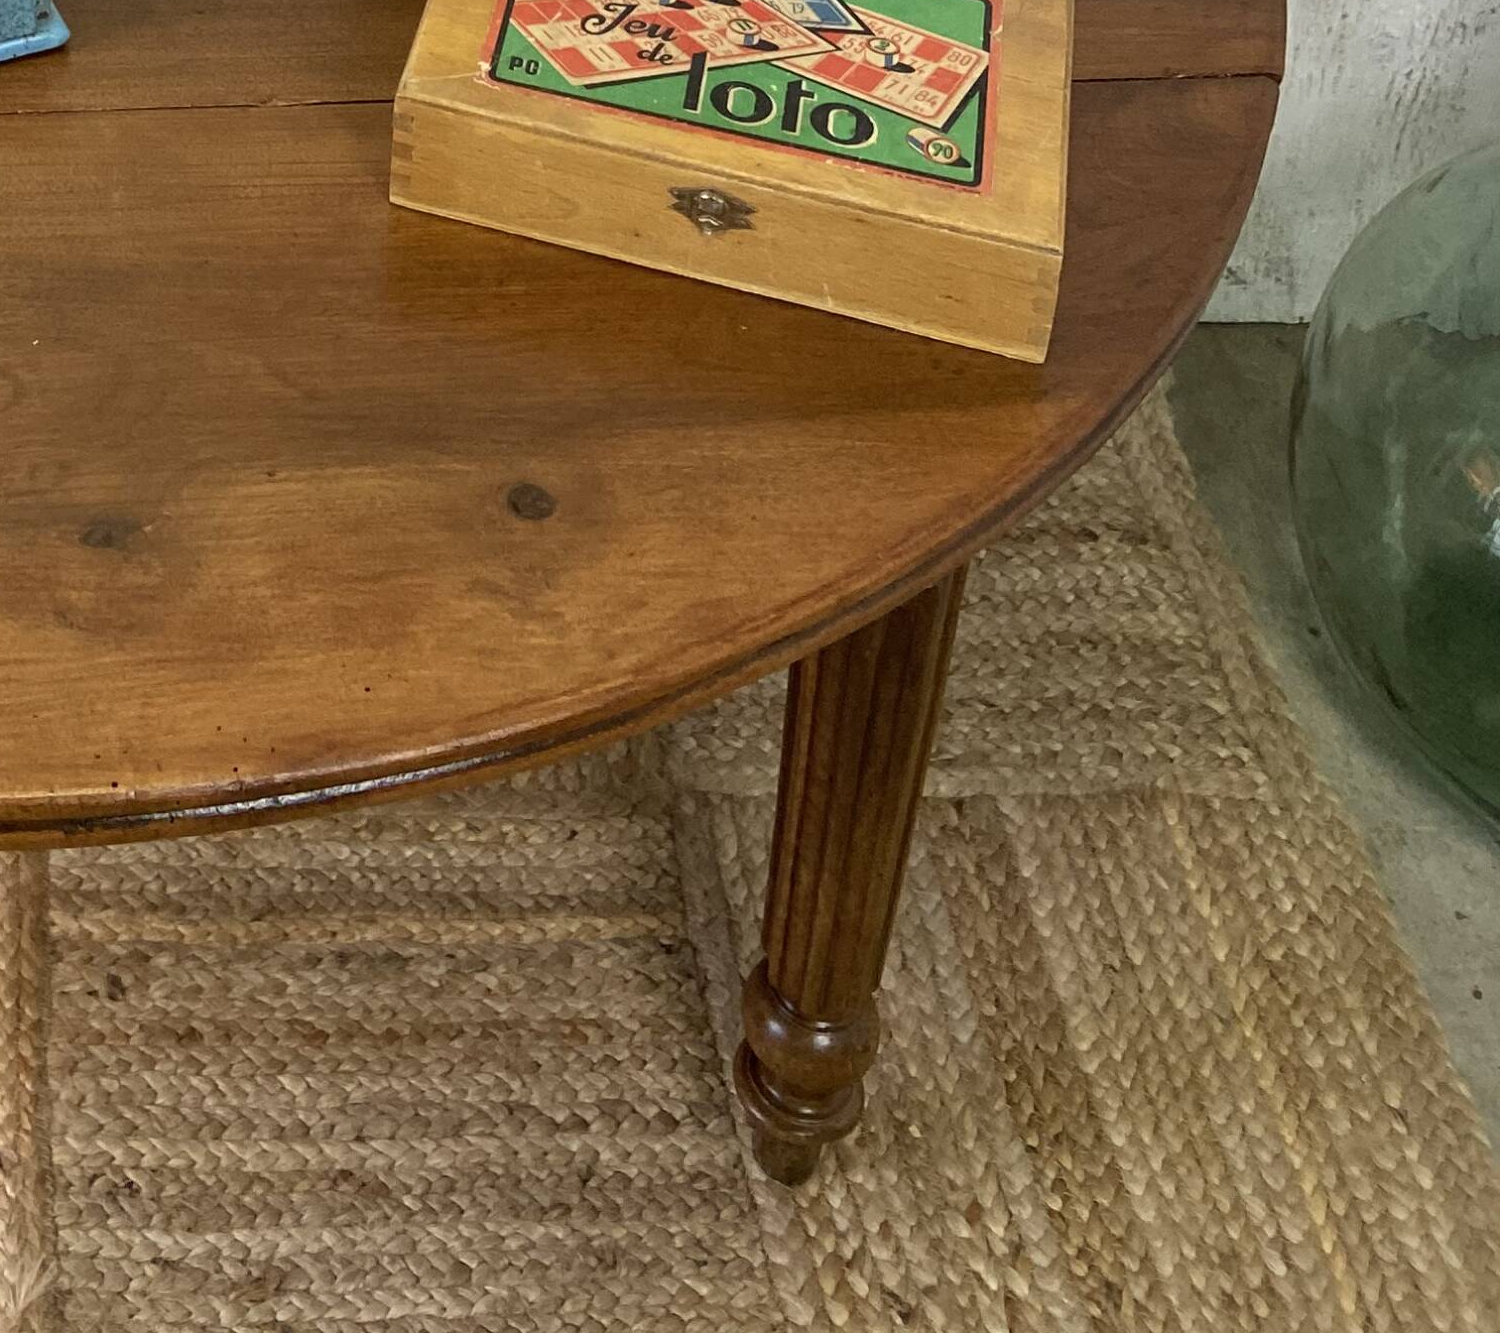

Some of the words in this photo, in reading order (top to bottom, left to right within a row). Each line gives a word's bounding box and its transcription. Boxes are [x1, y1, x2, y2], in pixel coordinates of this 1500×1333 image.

[580, 2, 679, 42] Jeu
[636, 42, 675, 66] de
[947, 49, 974, 67] 80
[683, 50, 879, 149] loto
[883, 79, 909, 95] 71
[914, 90, 939, 108] 84
[932, 141, 954, 160] 90
